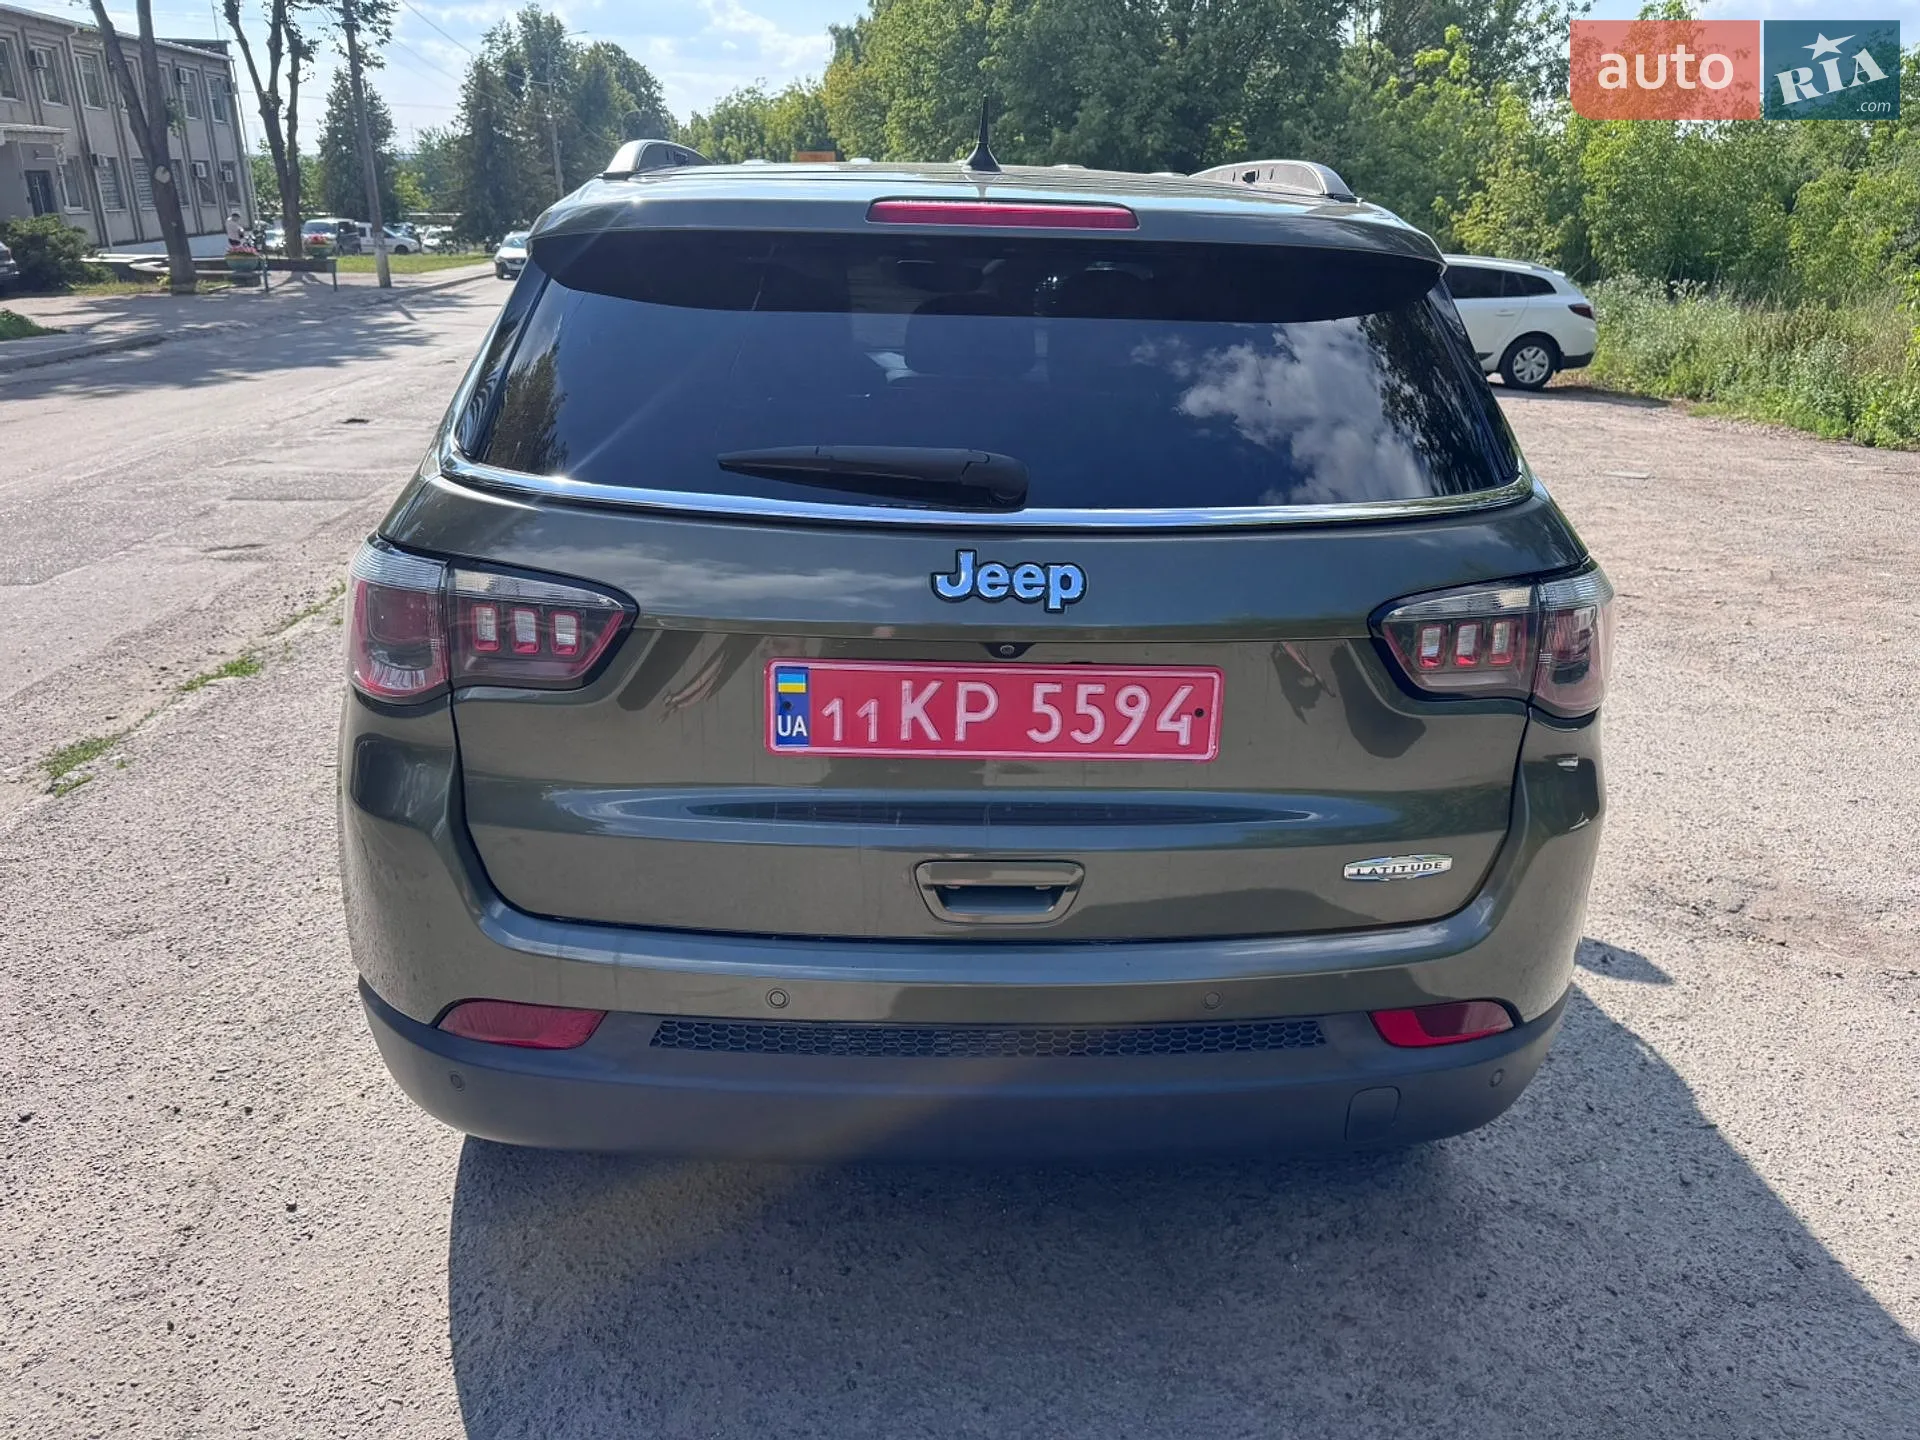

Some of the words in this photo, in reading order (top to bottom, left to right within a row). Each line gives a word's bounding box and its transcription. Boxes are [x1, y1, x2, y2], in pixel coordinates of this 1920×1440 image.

[933, 549, 1085, 612] Jeep
[778, 714, 808, 737] UA
[820, 697, 879, 742] 11
[901, 679, 1000, 742] KP
[1026, 682, 1194, 746] 5594
[1357, 861, 1443, 875] LATITUDE
